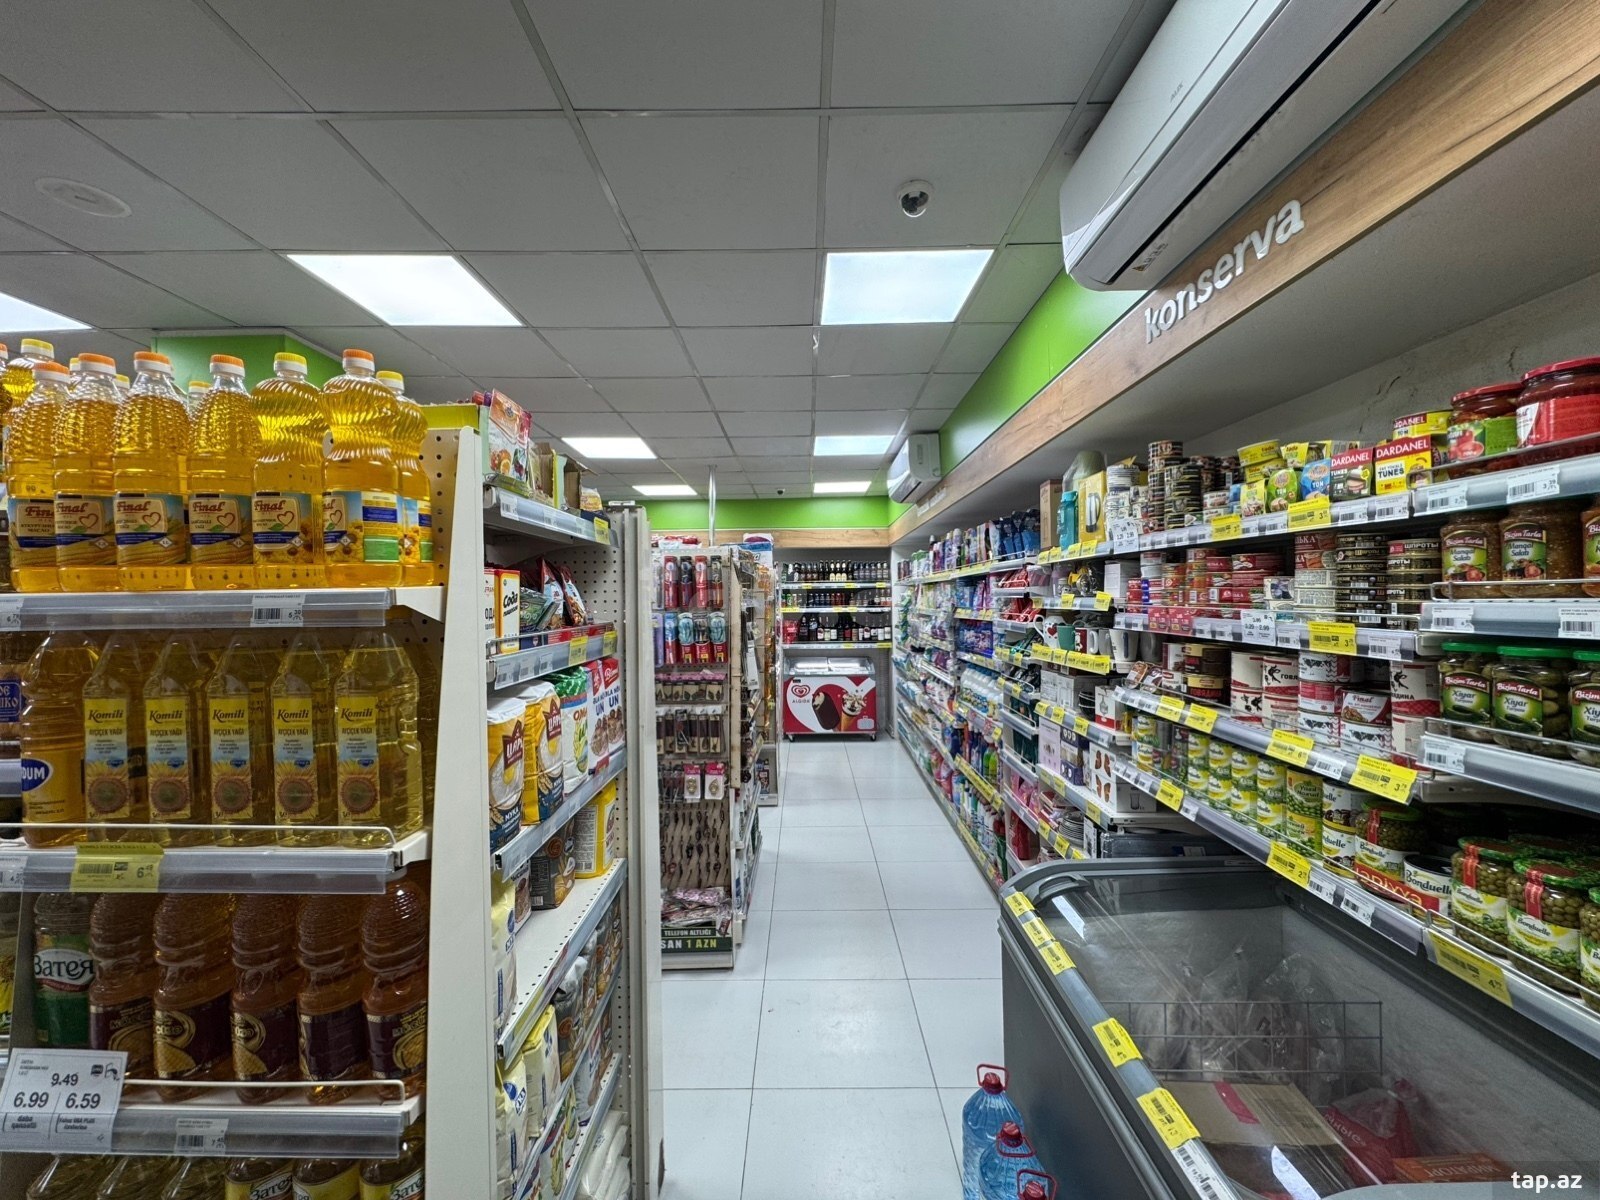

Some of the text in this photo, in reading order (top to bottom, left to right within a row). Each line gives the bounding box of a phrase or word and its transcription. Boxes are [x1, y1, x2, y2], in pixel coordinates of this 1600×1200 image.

[1145, 199, 1305, 344] konserva
[1376, 439, 1428, 458] DARDANEL
[1331, 452, 1369, 467] DARDANEL
[1378, 468, 1405, 479] TUNES
[117, 501, 151, 512] Final
[192, 502, 225, 512] Final
[254, 500, 286, 511] Final
[1463, 537, 1483, 545] Tarla
[503, 591, 518, 608] Сода
[1444, 676, 1487, 688] Bizim Tarla
[1452, 691, 1475, 700] Xiyar
[1497, 683, 1538, 696] Bizim Tarla
[609, 695, 619, 708] UN
[1504, 697, 1528, 708] Xiyar
[88, 709, 123, 723] Komili
[149, 710, 182, 724] Komili
[213, 709, 244, 723] Komili
[277, 709, 309, 722] Komili
[341, 708, 373, 722] Komili
[1394, 783, 1399, 791] 3
[505, 807, 519, 821] МУКА
[137, 866, 144, 878] 6
[1517, 916, 1550, 937] Bonduelle
[687, 940, 691, 948] 1
[696, 939, 717, 948] AZN
[51, 1073, 79, 1087] 9.49
[13, 1092, 101, 1109] 6.99 6.59
